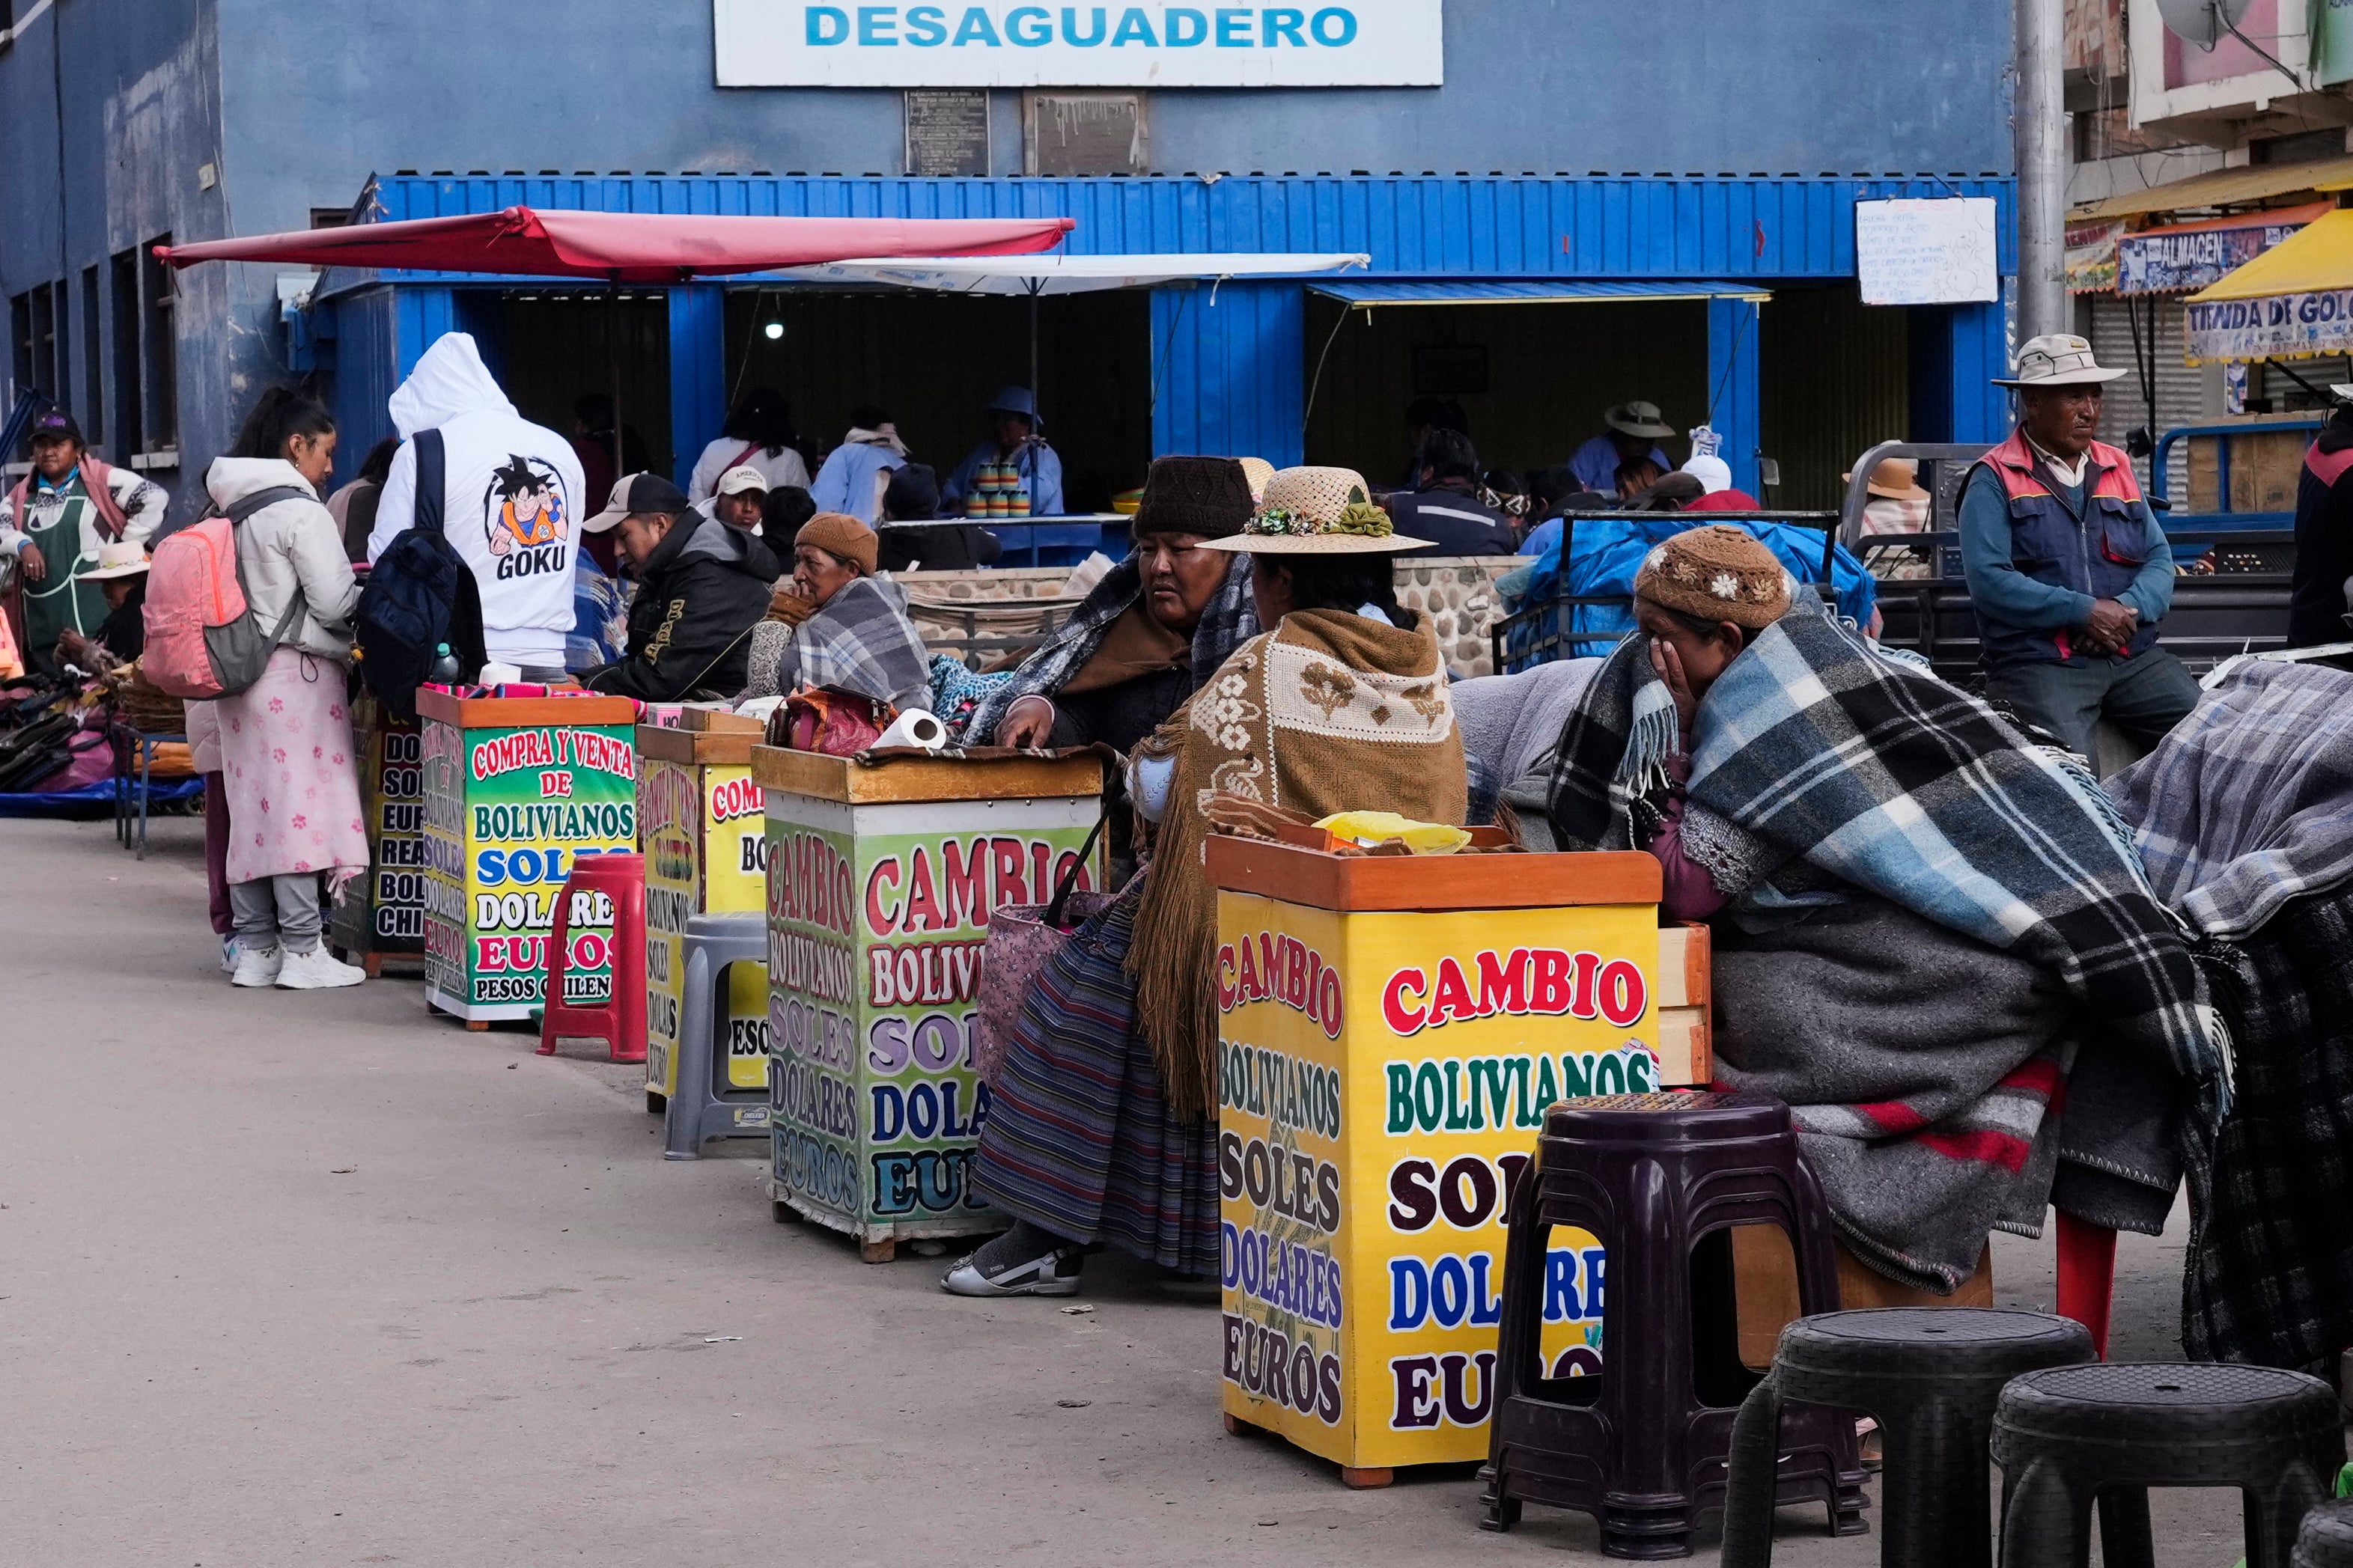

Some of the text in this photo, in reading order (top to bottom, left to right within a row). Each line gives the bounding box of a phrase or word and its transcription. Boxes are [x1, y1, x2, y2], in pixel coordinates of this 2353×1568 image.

[805, 5, 1358, 48] DESAGUADERO
[2188, 302, 2263, 332] TIENDA
[497, 546, 566, 580] GOKU
[472, 729, 635, 781] COMPRA Y VENTA
[539, 770, 572, 798] DE
[474, 802, 635, 842] BOLIVIANOS
[424, 832, 466, 882] SOLES
[477, 847, 631, 885] SOL
[767, 830, 853, 937] CAMBIO
[424, 875, 467, 926] DOLARES
[425, 917, 467, 968] EUROS
[768, 925, 853, 1007] BOLIVIANOS
[475, 976, 536, 1001] PESOS
[1219, 933, 1344, 1040] CAMBIO
[1381, 945, 1648, 1038] CAMBIO
[728, 1019, 769, 1056] ESO
[769, 991, 855, 1076] SOLES
[770, 1054, 857, 1144] DOLARES
[1219, 1038, 1341, 1144] BOLIVIANOS
[1384, 1048, 1652, 1137] BOLIVIANOS
[771, 1120, 859, 1214] EUROS
[1220, 1129, 1341, 1237] SOLES
[1221, 1219, 1343, 1331] DOLARES
[1222, 1311, 1343, 1428] EUROS
